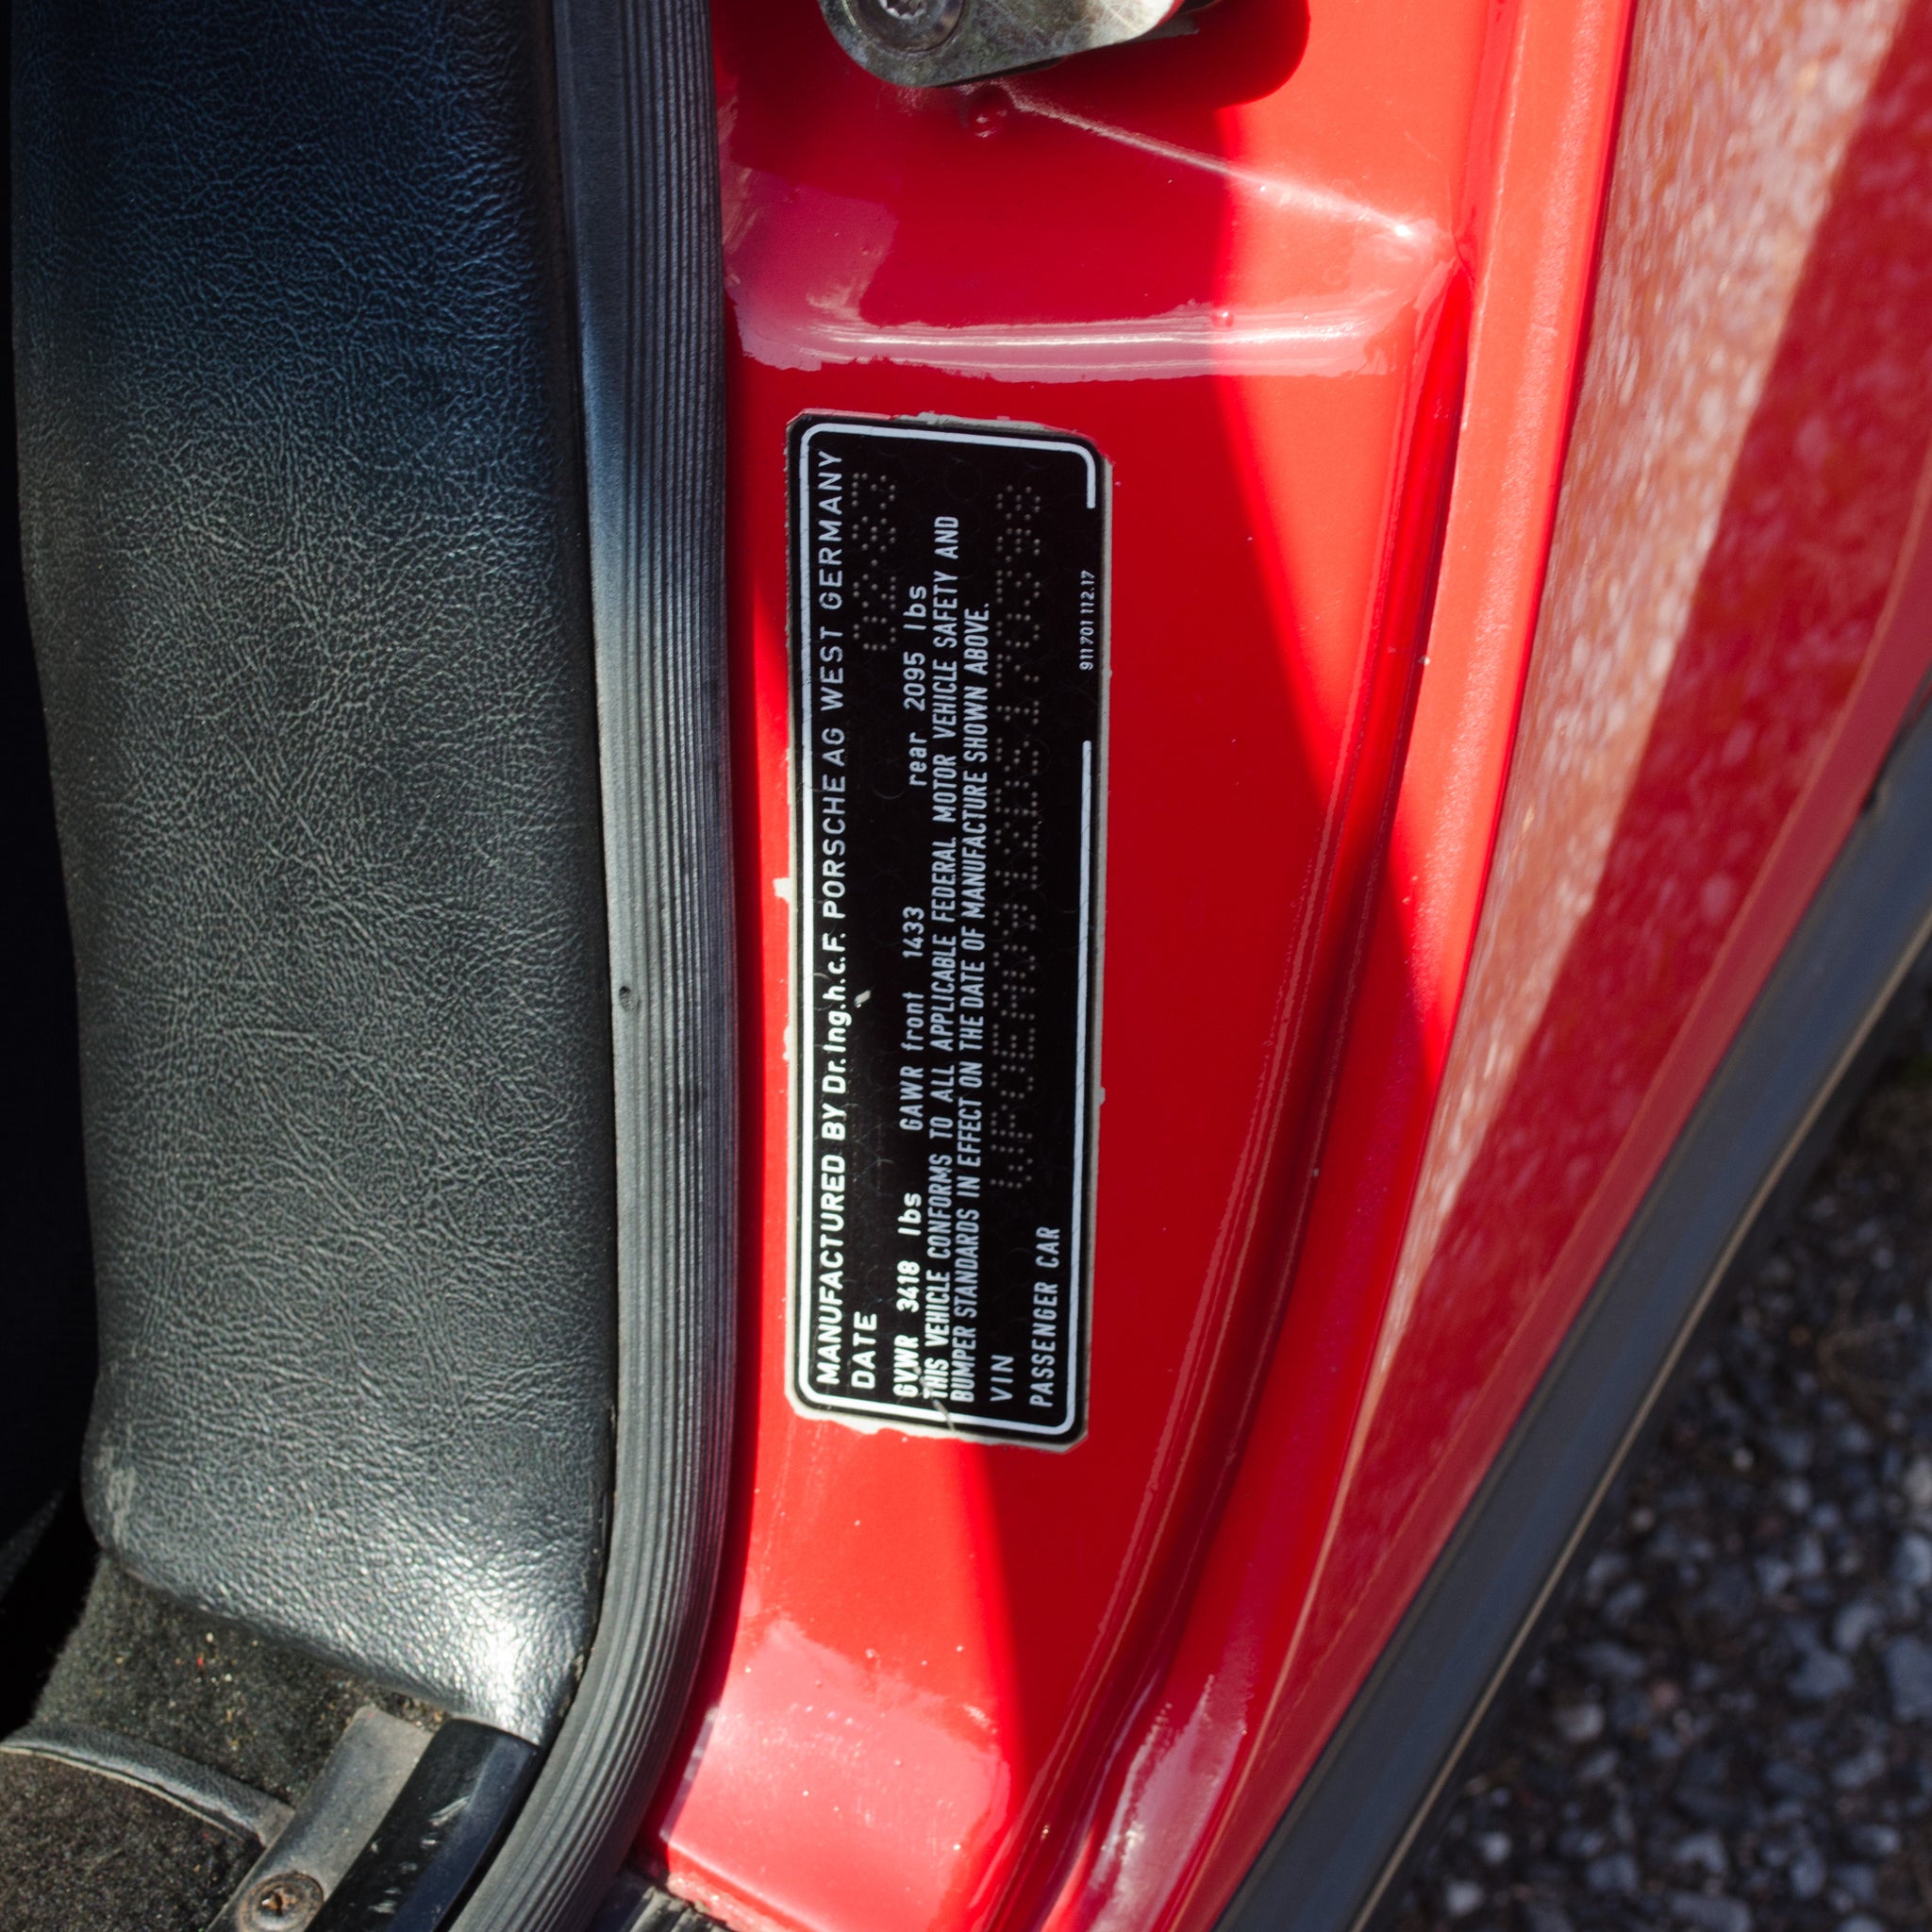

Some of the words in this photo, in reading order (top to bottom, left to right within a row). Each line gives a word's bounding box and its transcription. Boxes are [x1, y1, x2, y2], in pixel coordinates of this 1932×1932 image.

[818, 451, 842, 609] GERMANY
[934, 516, 958, 559] AND
[903, 586, 926, 630] lbs
[933, 571, 958, 648] SAFETY
[1079, 570, 1095, 615] 112.17
[820, 626, 843, 711] WEST
[963, 603, 989, 675] ABOVE.
[903, 651, 925, 711] 2095
[932, 660, 958, 739] VEHICLE
[822, 728, 845, 767] AG
[963, 686, 988, 762] SHOWN
[908, 732, 927, 786] rear
[932, 754, 958, 823] MOTOR
[822, 774, 845, 919] PORSCHE
[961, 771, 988, 919] MANUFACTURE
[931, 837, 957, 923] FEDERAL
[902, 907, 924, 958] 1433
[961, 925, 985, 951] OF
[930, 934, 957, 1052] APPLICABLE
[960, 959, 985, 1008] DATE
[901, 991, 924, 1051] front
[959, 1015, 984, 1051] THE
[899, 1066, 924, 1130] GAWR
[930, 1065, 955, 1103] ALL
[958, 1061, 983, 1088] ON
[822, 1103, 847, 1141] BY
[929, 1116, 954, 1139] TO
[957, 1097, 982, 1167] EFFECT
[897, 1192, 922, 1236] lbs
[926, 1154, 952, 1258] CONFORMS
[957, 1175, 980, 1198] IN
[816, 1155, 845, 1385] MANUFACTURED
[954, 1208, 979, 1318] STANDARDS
[1036, 1226, 1060, 1268] CAR
[896, 1260, 920, 1312] 3418
[924, 1271, 950, 1347] VEHICLE
[851, 1311, 877, 1390] DATE
[892, 1335, 921, 1397] GVWR
[952, 1325, 975, 1403] BUMPER
[1029, 1282, 1058, 1407] PASSENGER
[924, 1357, 949, 1399] THIS
[990, 1355, 1014, 1401] VIN
